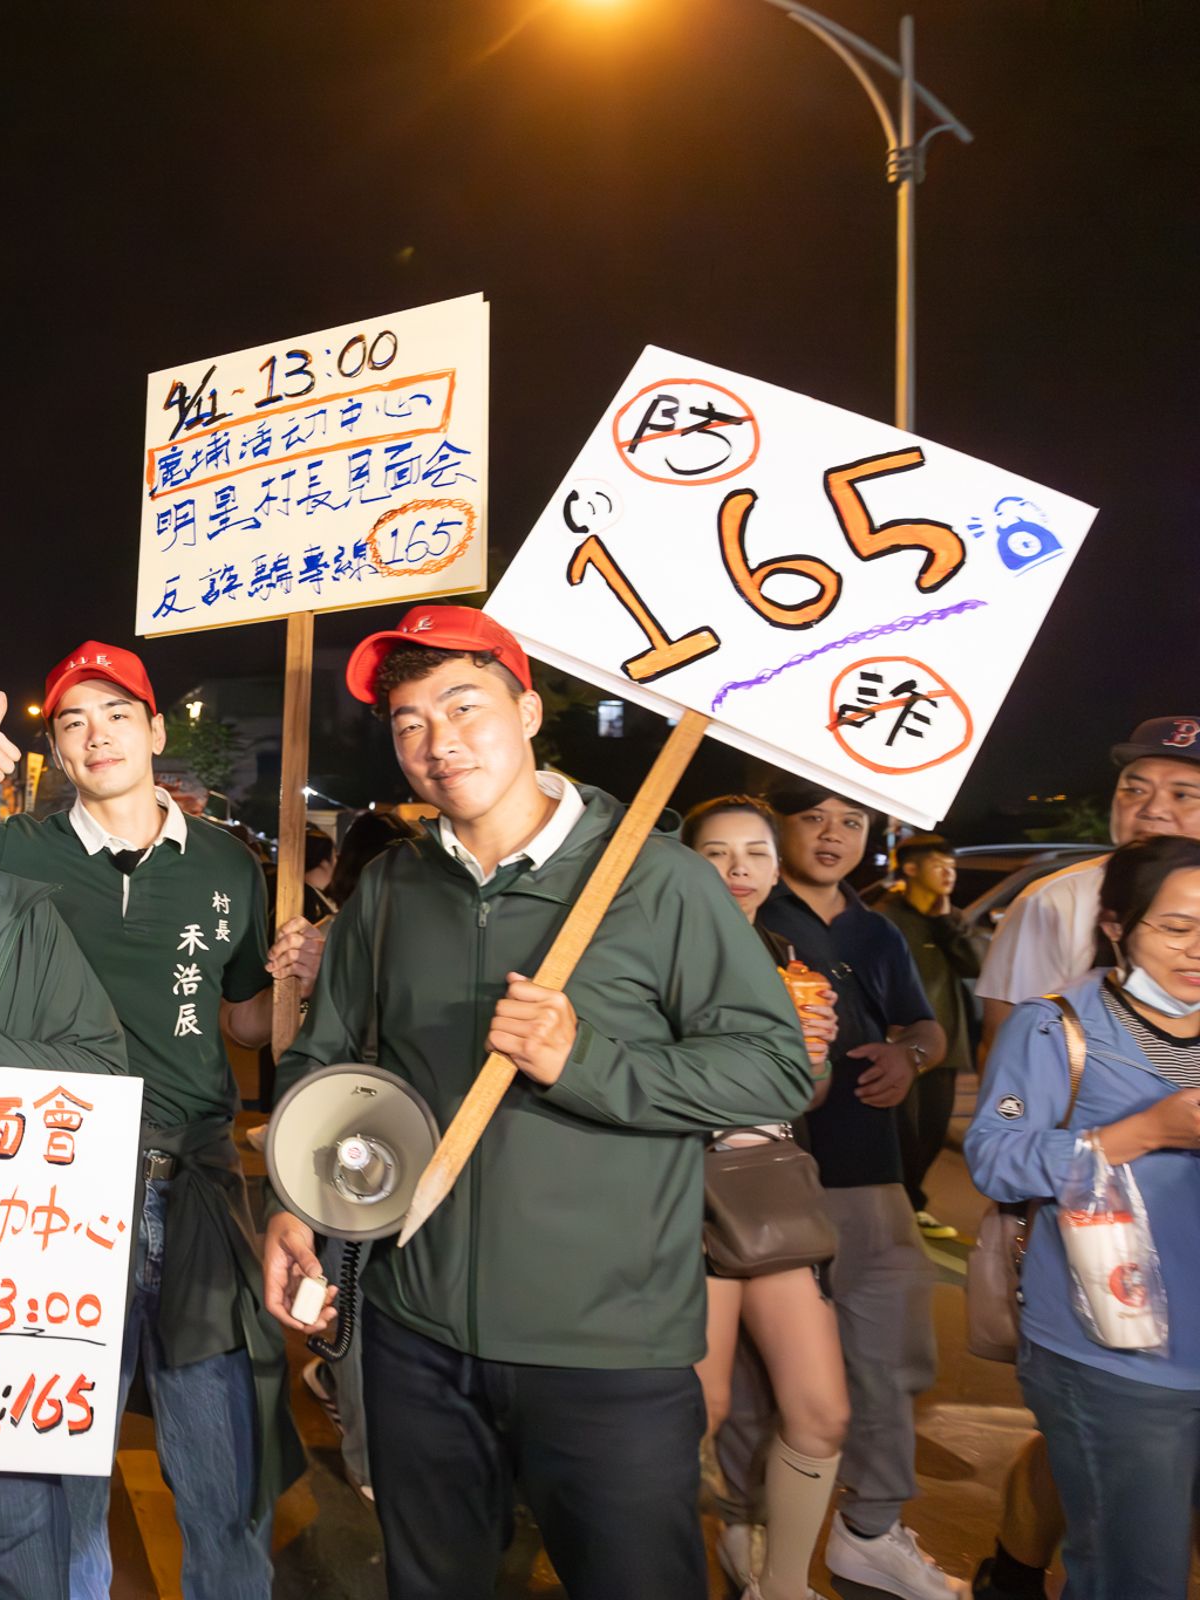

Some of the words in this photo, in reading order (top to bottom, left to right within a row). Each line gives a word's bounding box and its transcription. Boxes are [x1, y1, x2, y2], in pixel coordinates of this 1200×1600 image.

[381, 519, 464, 566] 165
[566, 446, 967, 684] 165
[837, 670, 940, 747] 詐
[1163, 719, 1200, 747] B
[212, 890, 231, 942] 村長
[172, 923, 210, 1037] 禾浩辰
